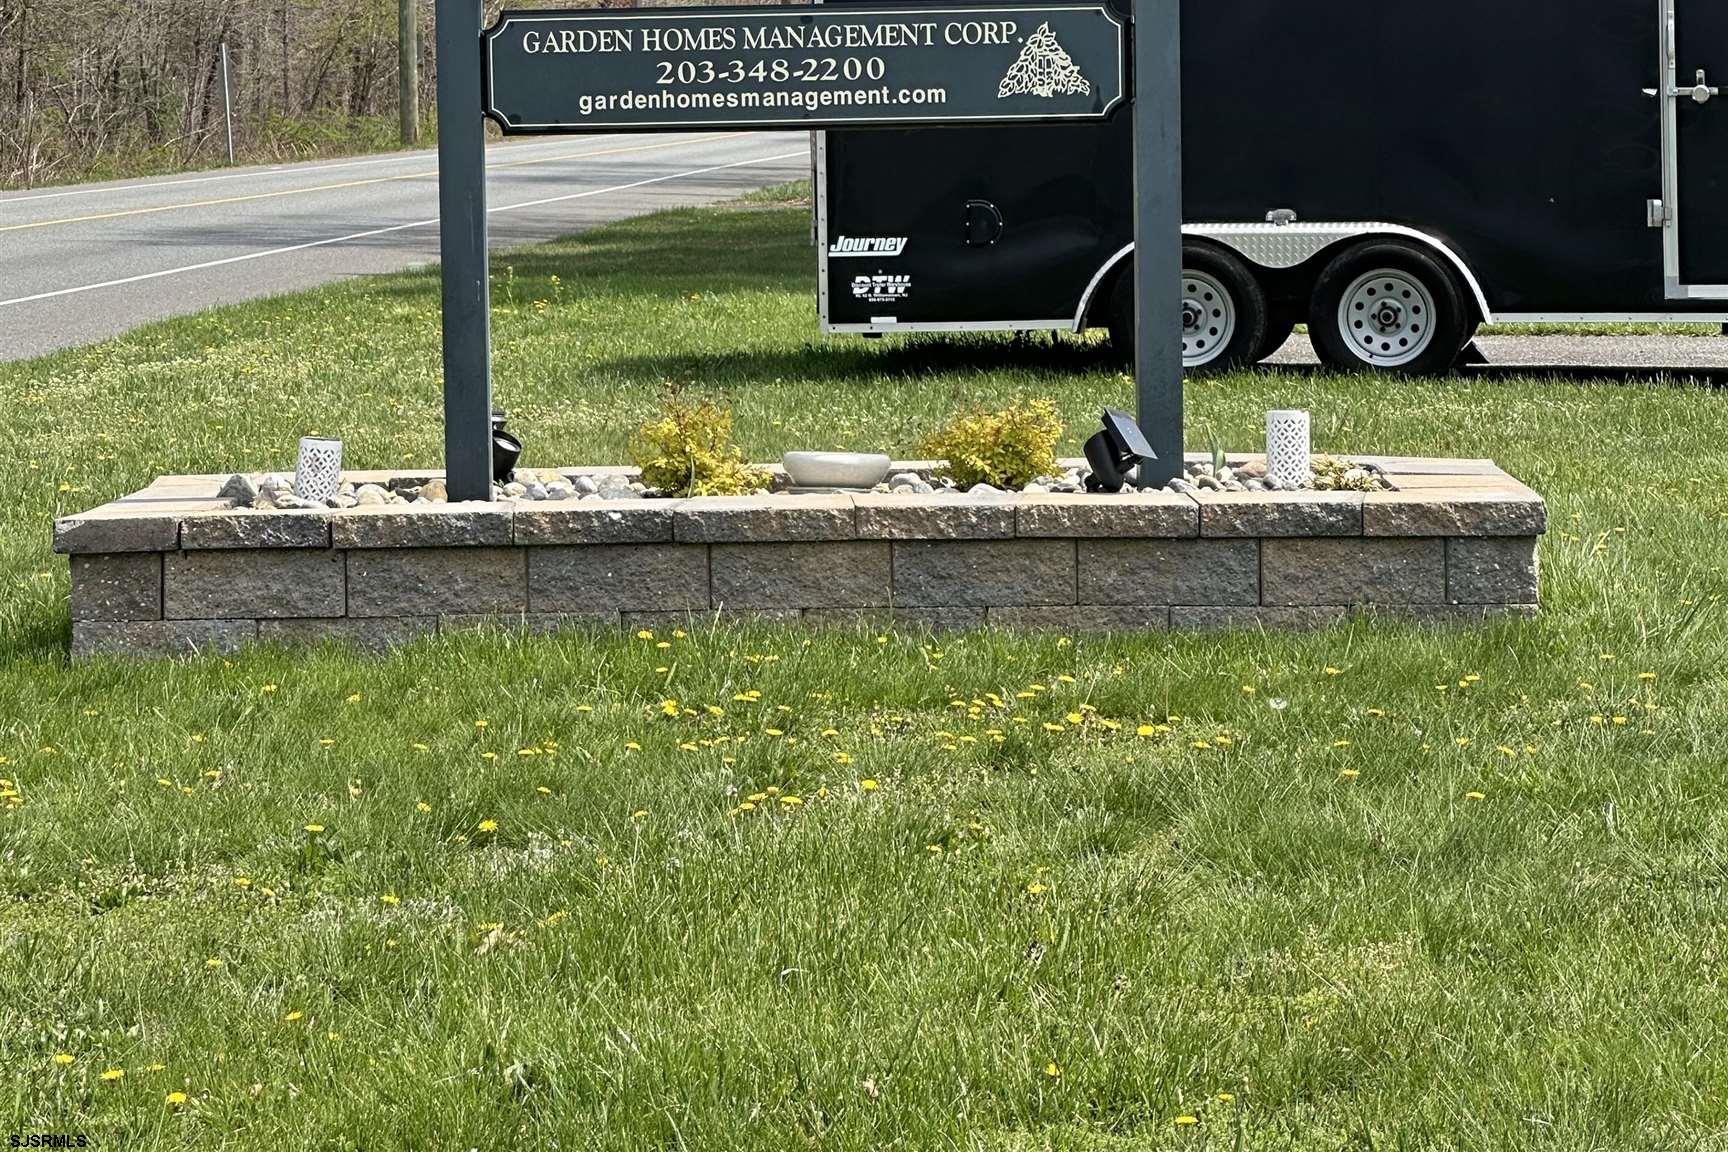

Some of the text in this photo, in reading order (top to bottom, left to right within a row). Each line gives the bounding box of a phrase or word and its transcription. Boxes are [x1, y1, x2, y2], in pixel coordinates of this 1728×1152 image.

[523, 21, 1024, 53] GARDEN HOMES MANAGEMENT CORP.
[656, 57, 885, 84] 203-348-2200
[578, 86, 946, 115] gardenhomesmanagement.com
[828, 235, 908, 257] Journey
[852, 275, 911, 294] DTW
